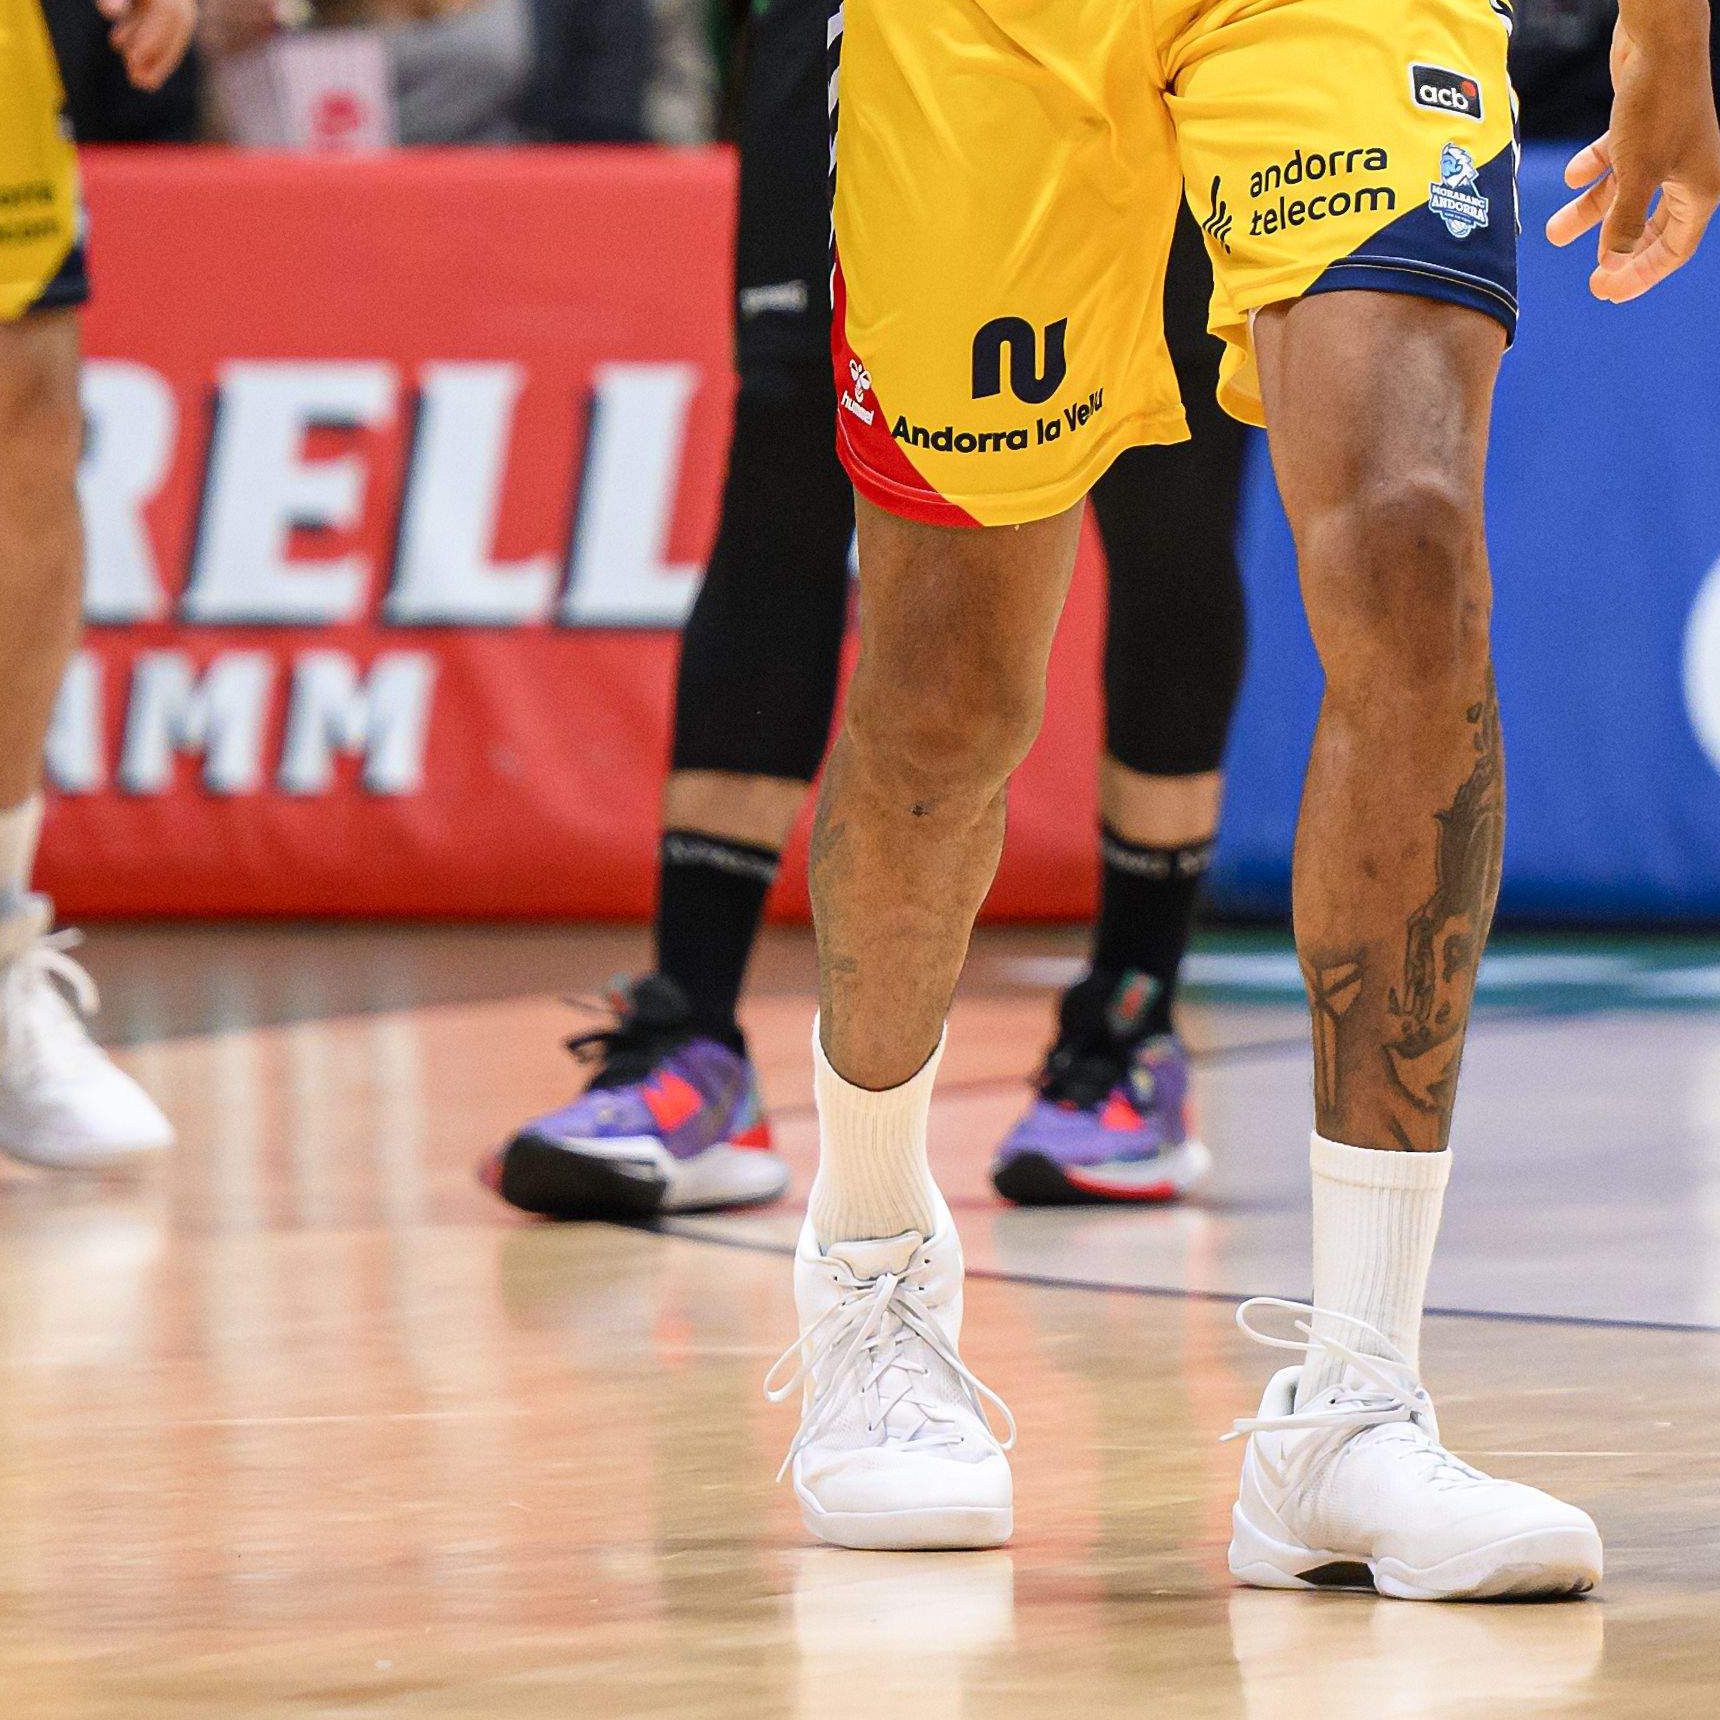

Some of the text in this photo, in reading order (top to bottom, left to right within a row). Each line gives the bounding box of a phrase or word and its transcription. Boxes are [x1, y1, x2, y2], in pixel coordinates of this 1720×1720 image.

[1419, 82, 1469, 110] acb
[1249, 147, 1388, 198] andorra
[1249, 187, 1396, 236] telecom
[1431, 194, 1485, 222] ANDORRA
[891, 415, 1028, 453] Andorra
[1036, 418, 1061, 445] la
